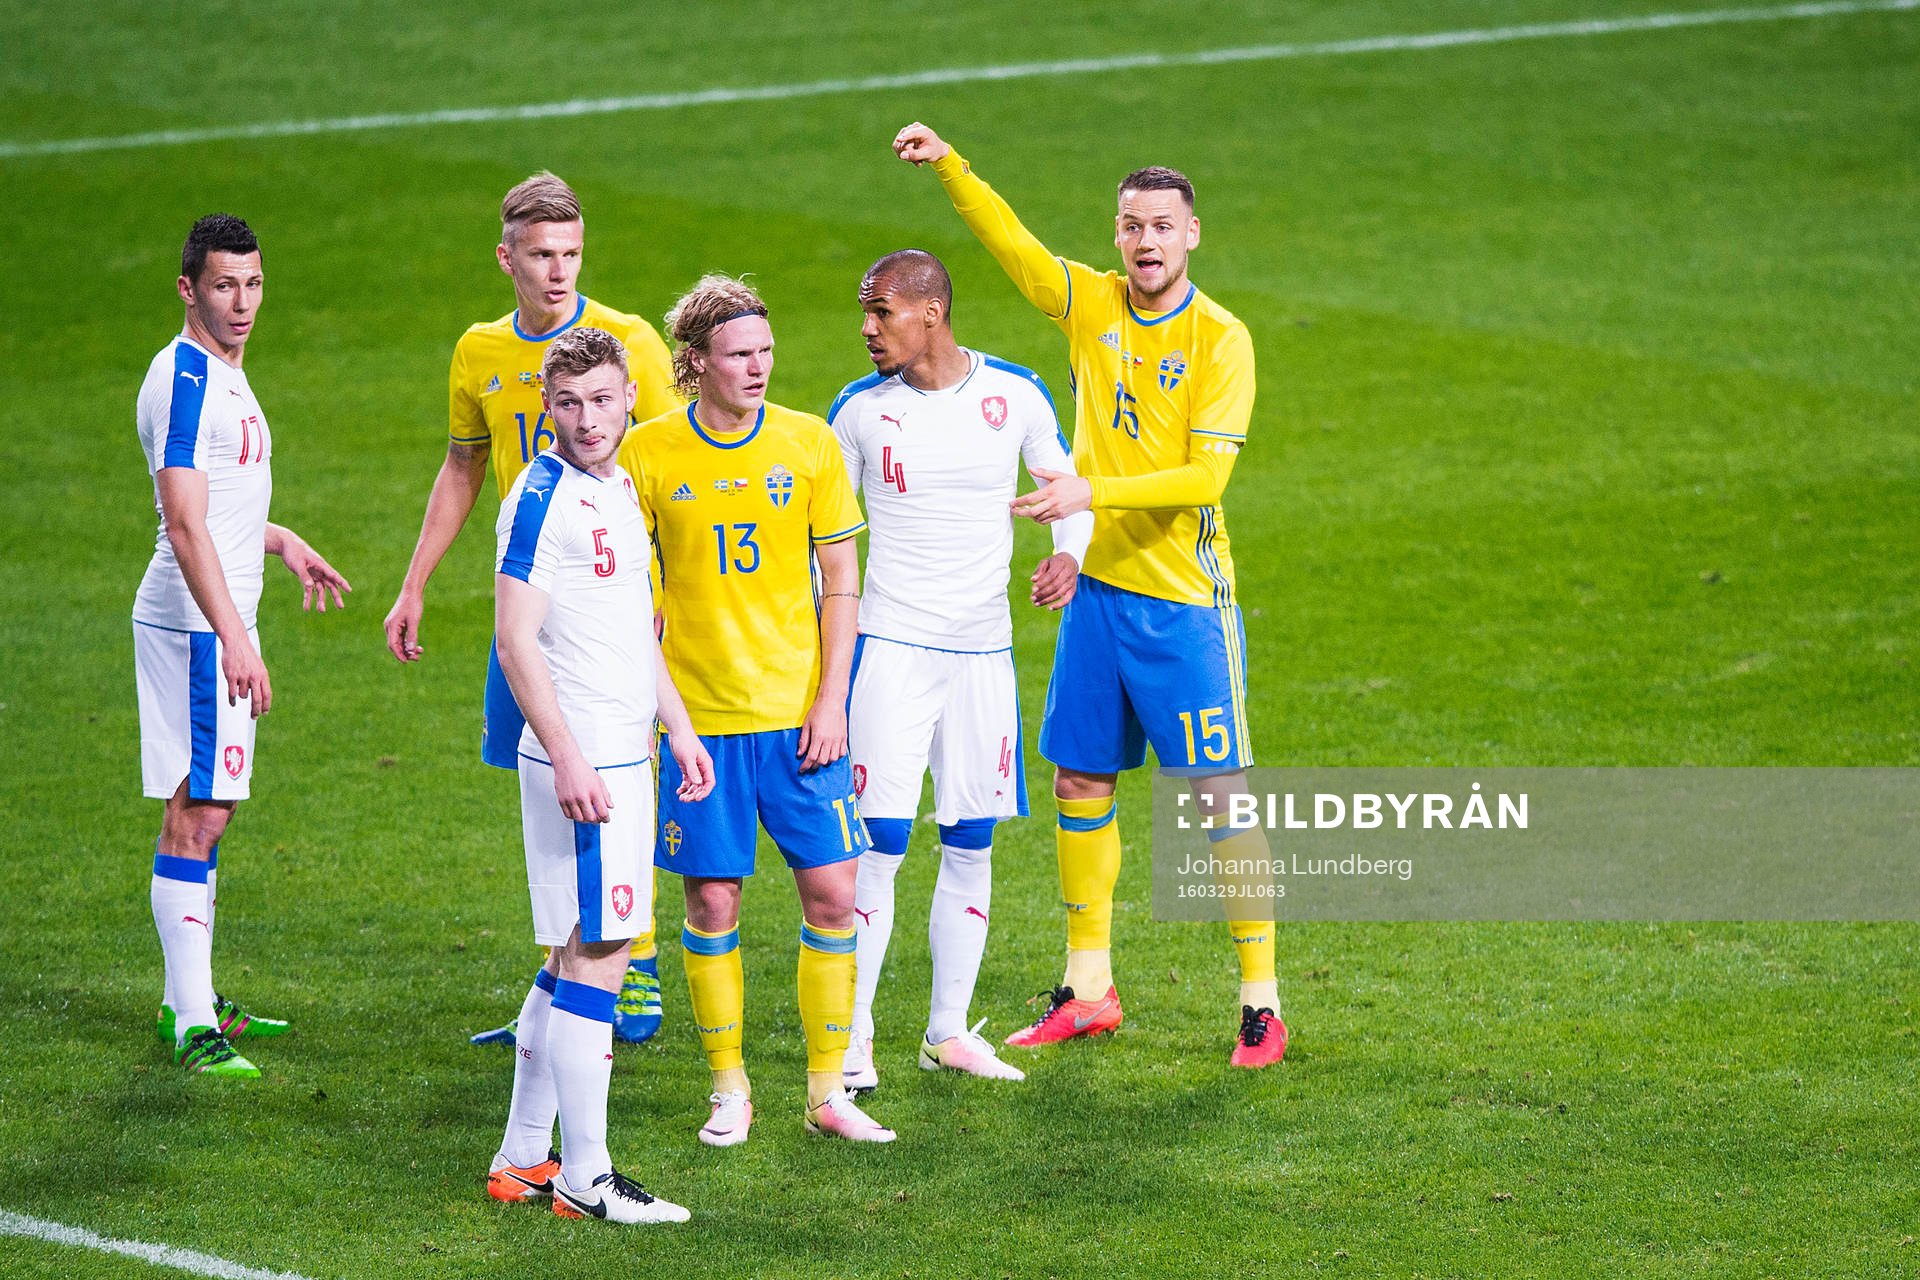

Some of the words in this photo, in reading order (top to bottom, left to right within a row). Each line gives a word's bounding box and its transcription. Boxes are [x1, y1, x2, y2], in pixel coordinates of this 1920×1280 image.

[1112, 381, 1139, 440] 15
[239, 416, 263, 465] 17
[515, 412, 556, 463] 16
[883, 446, 907, 493] 4
[592, 528, 616, 578] 5
[713, 523, 760, 574] 13
[998, 736, 1011, 779] 4
[1179, 706, 1231, 766] 15
